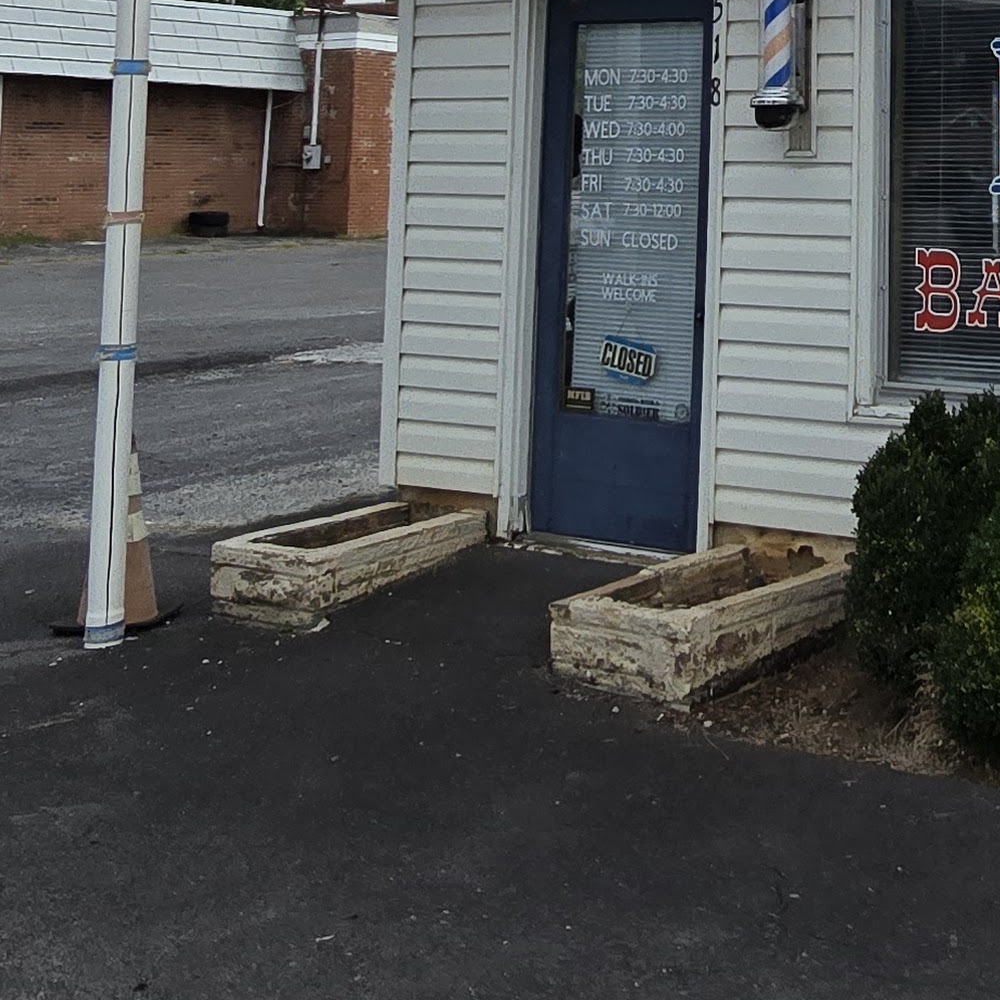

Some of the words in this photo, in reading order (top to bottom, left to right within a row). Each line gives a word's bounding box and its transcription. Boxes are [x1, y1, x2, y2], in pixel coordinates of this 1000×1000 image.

[584, 68, 621, 86] MON
[584, 95, 612, 112] TUE
[583, 121, 621, 138] WED
[582, 149, 613, 165] THU
[581, 174, 602, 192] FRI
[581, 202, 613, 221] SAT
[580, 229, 611, 247] SUN
[622, 231, 678, 250] CLOSED
[601, 287, 657, 302] WELCOME
[601, 342, 653, 377] CLOSED
